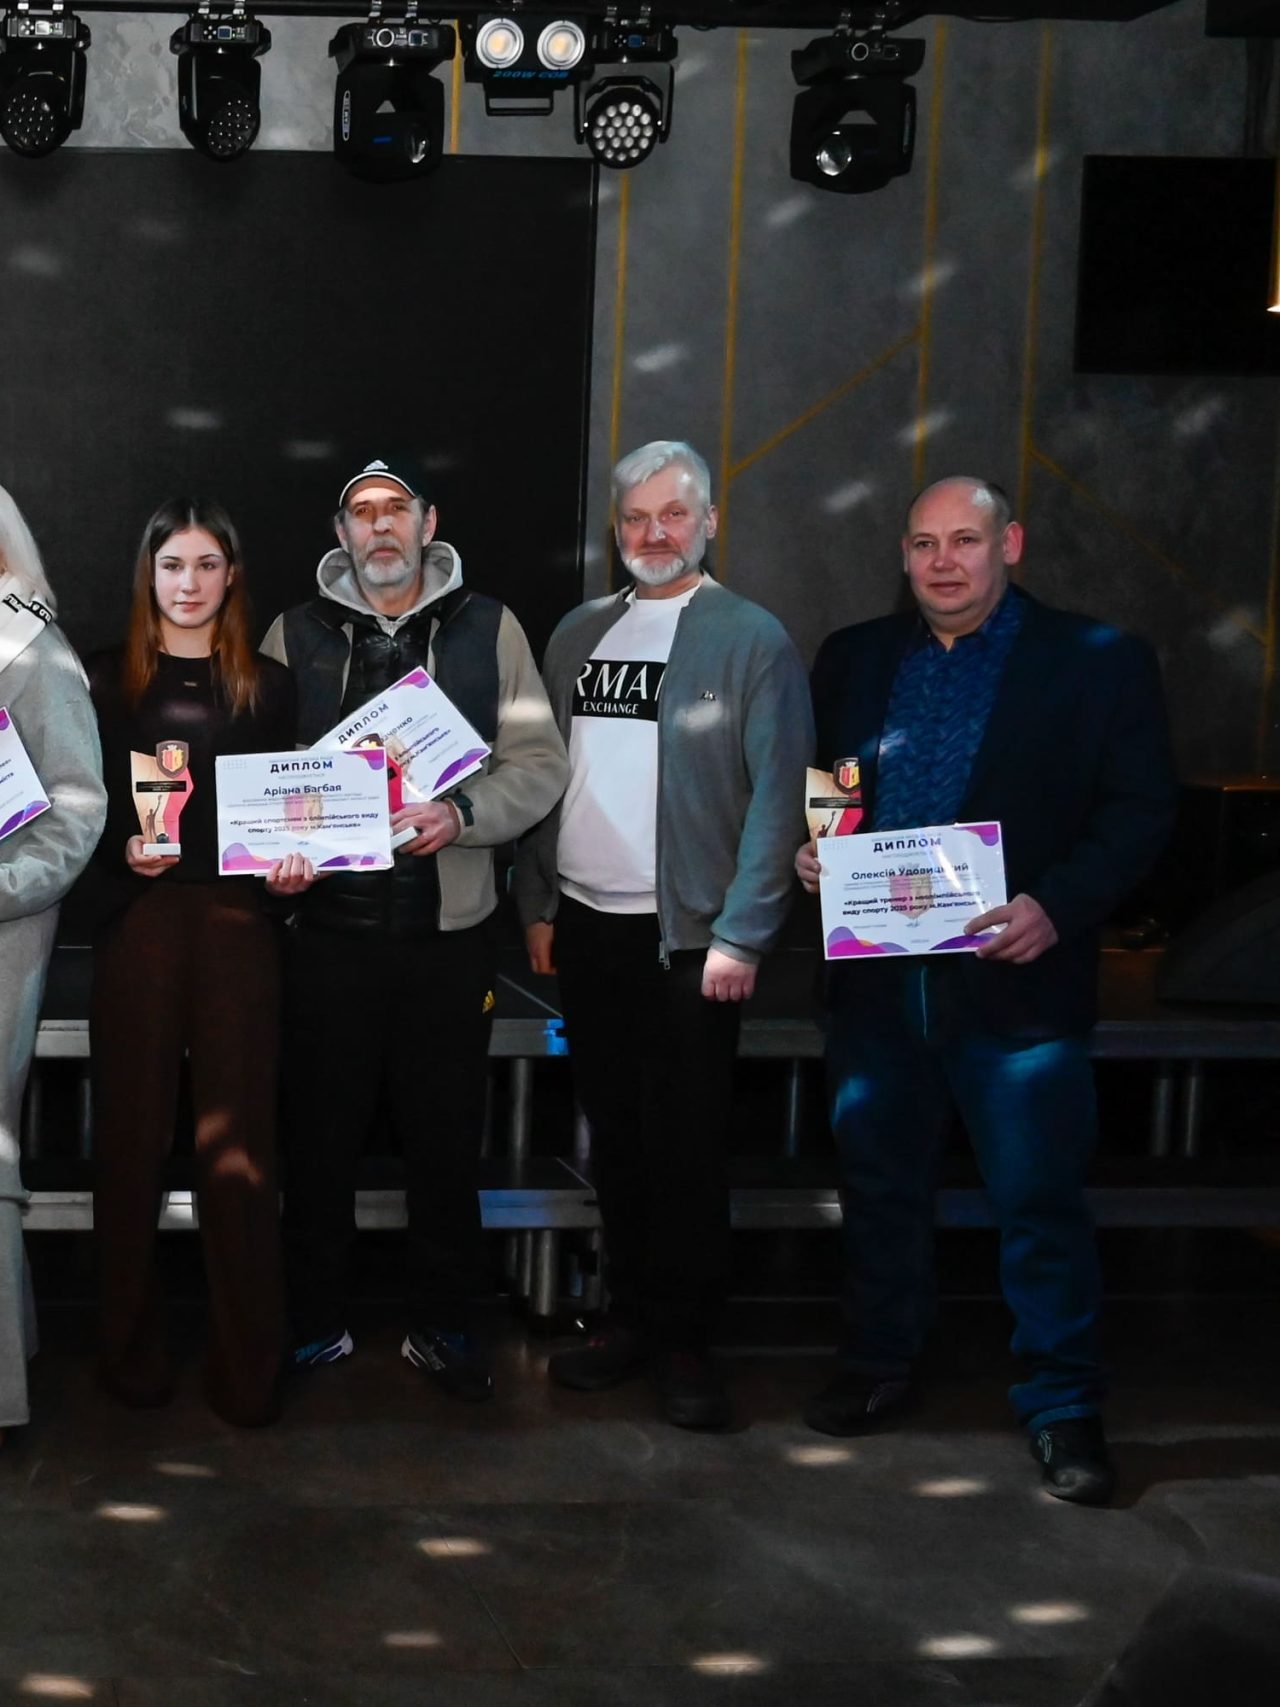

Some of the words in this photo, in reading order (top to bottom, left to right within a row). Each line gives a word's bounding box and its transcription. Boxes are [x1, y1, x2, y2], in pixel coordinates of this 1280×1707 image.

[583, 701, 639, 715] EXCHANGE
[338, 702, 390, 745] ДИПЛОМ
[270, 760, 333, 774] ДИПЛОМ
[264, 786, 301, 797] Аріана
[304, 783, 342, 794] Багбая
[873, 837, 941, 852] ДИПЛОМ
[851, 868, 896, 880] Олексій
